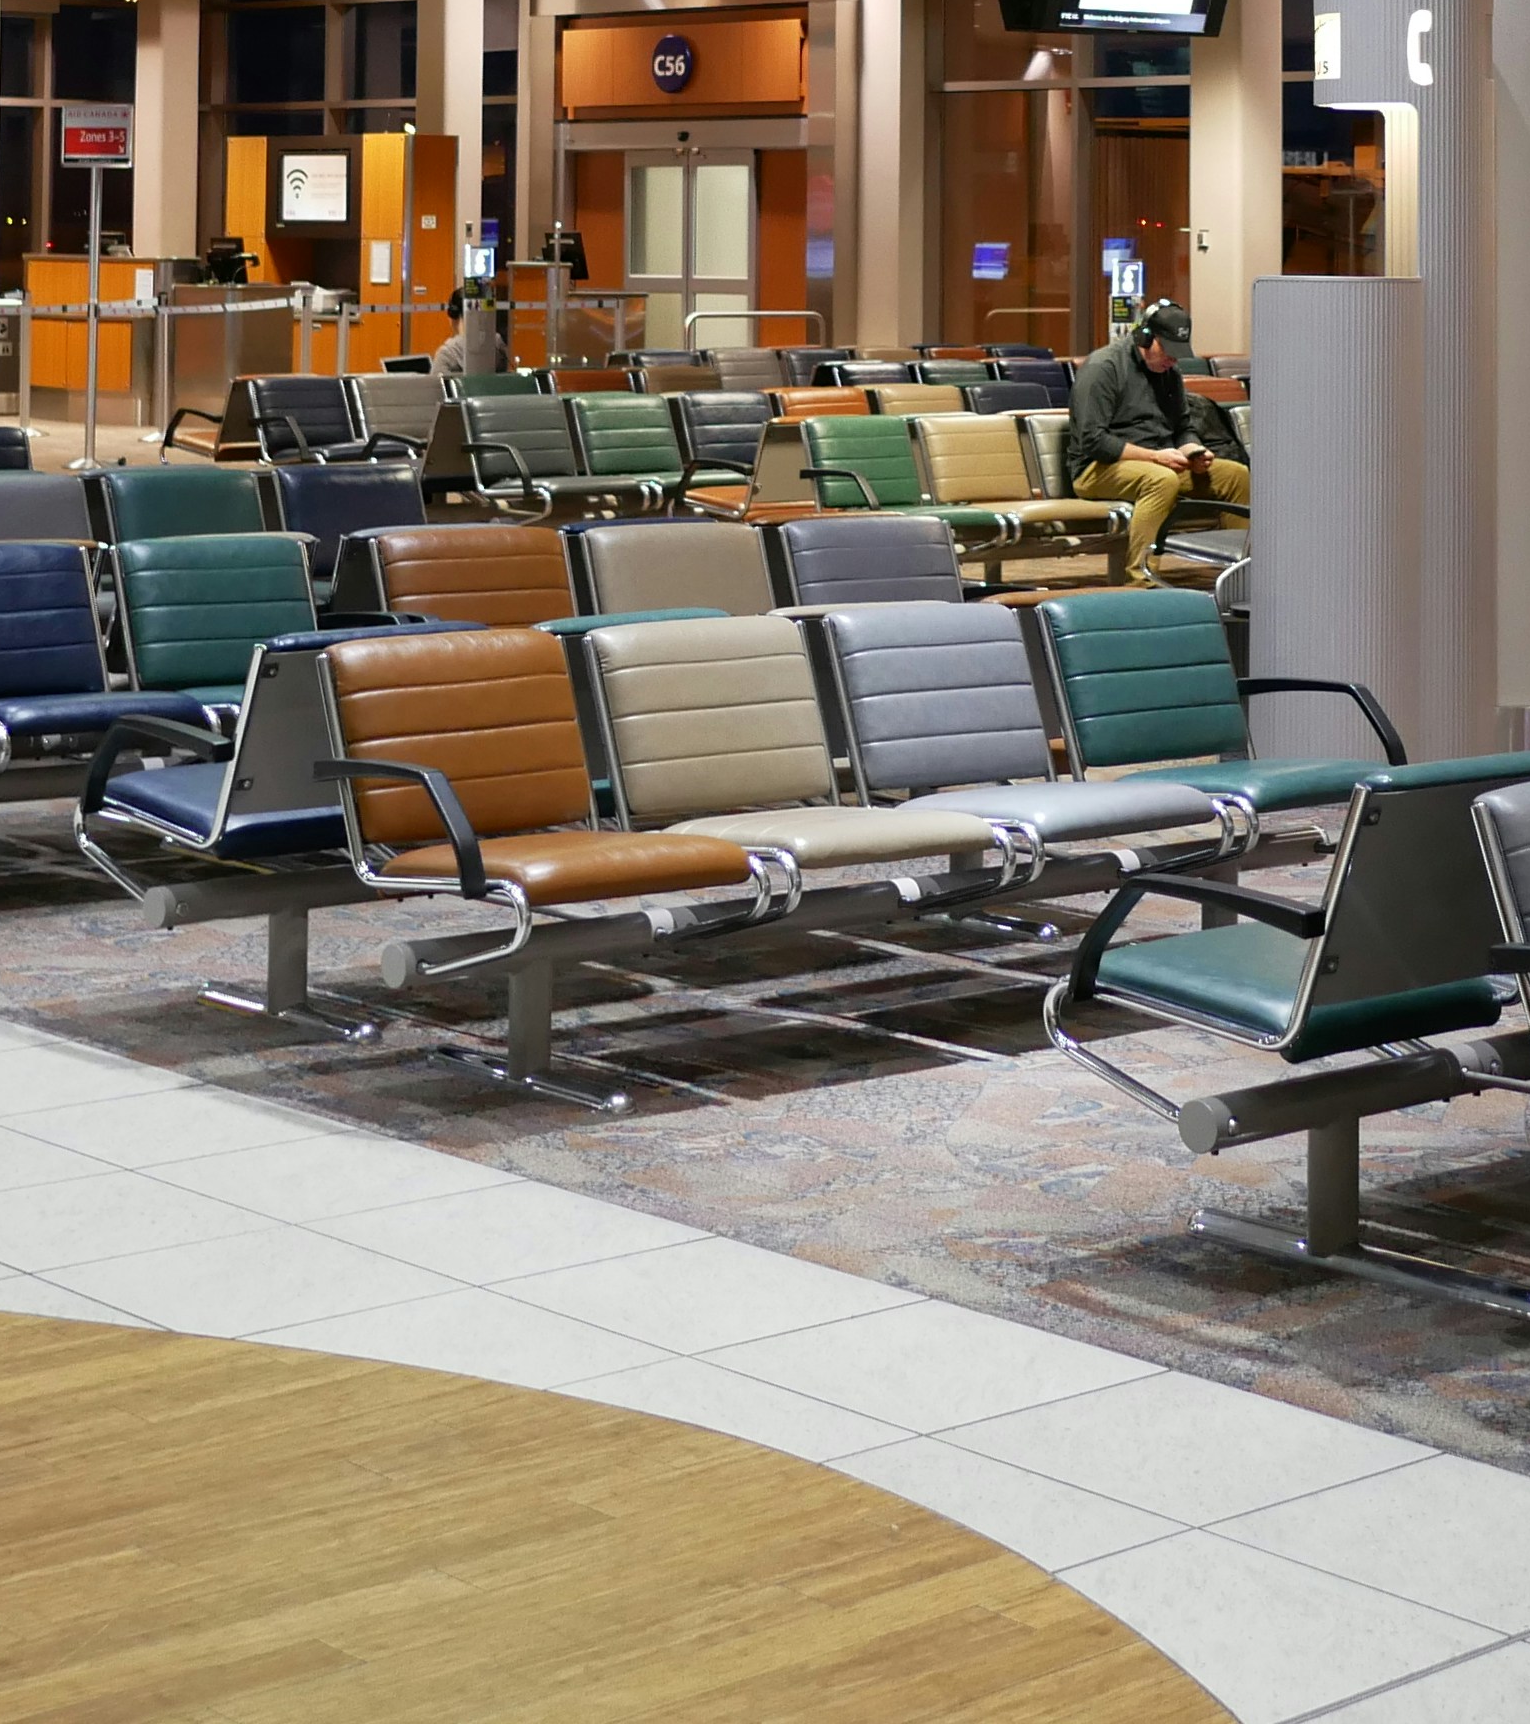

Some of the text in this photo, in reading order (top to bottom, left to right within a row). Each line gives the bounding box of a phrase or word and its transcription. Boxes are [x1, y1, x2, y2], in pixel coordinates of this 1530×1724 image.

[652, 54, 686, 77] C56
[84, 110, 118, 118] CANADA
[79, 130, 106, 143] Zones
